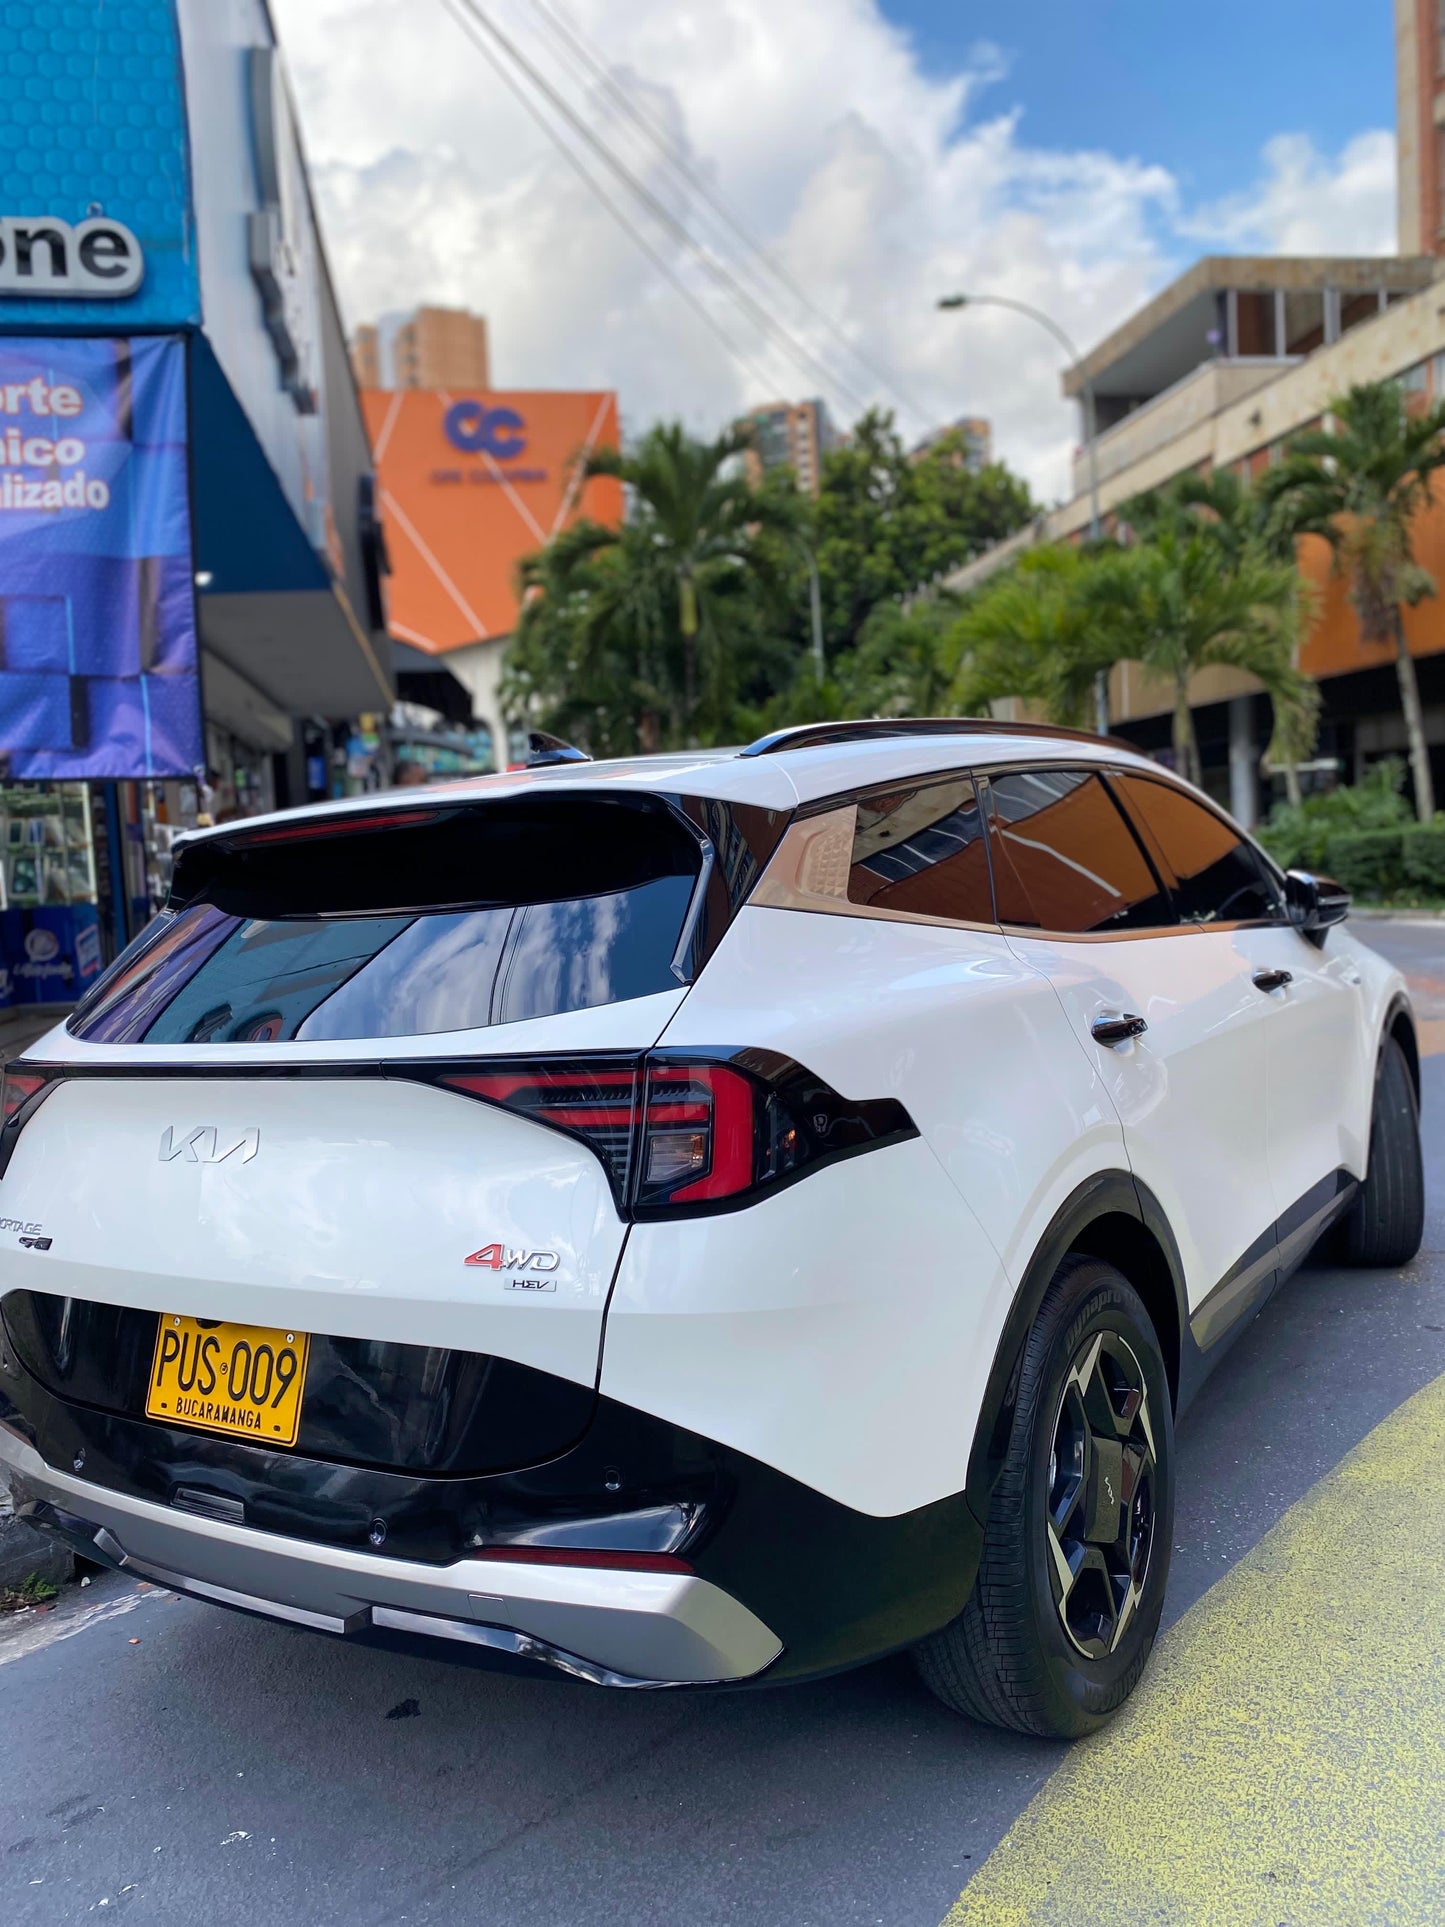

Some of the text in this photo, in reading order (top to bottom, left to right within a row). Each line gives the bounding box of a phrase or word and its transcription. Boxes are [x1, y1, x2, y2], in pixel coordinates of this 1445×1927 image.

[0, 228, 131, 279] ne
[0, 376, 83, 417] rte
[158, 1125, 260, 1165] KIA
[463, 1243, 560, 1271] 4WD
[512, 1279, 550, 1289] HEV
[176, 1396, 261, 1430] BUCARAMANGA
